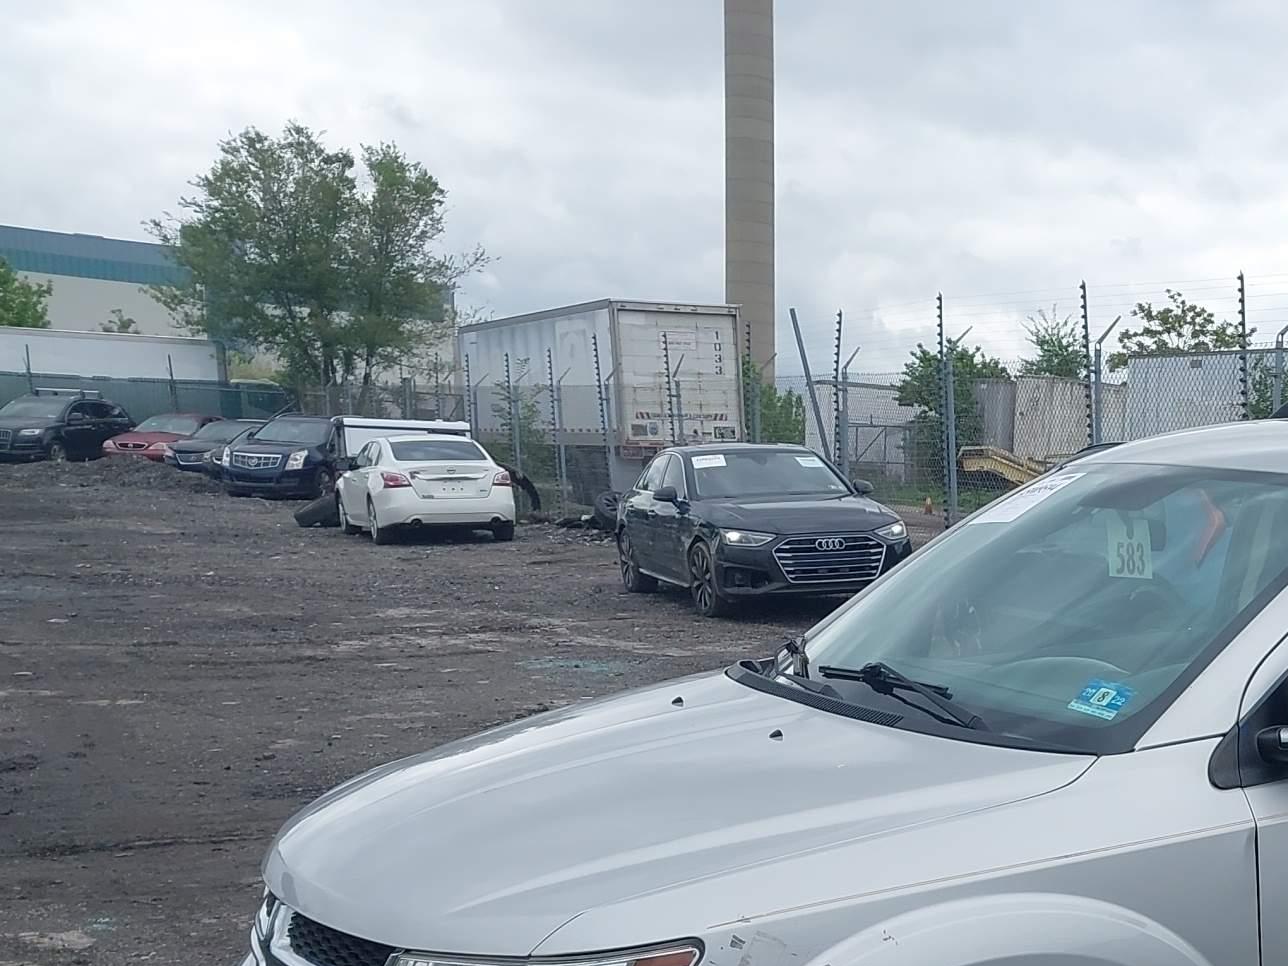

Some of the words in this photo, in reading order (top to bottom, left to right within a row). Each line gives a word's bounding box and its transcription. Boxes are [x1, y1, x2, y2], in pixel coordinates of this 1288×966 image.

[713, 330, 723, 376] 1033
[1115, 541, 1146, 576] 583
[1096, 690, 1111, 703] 8
